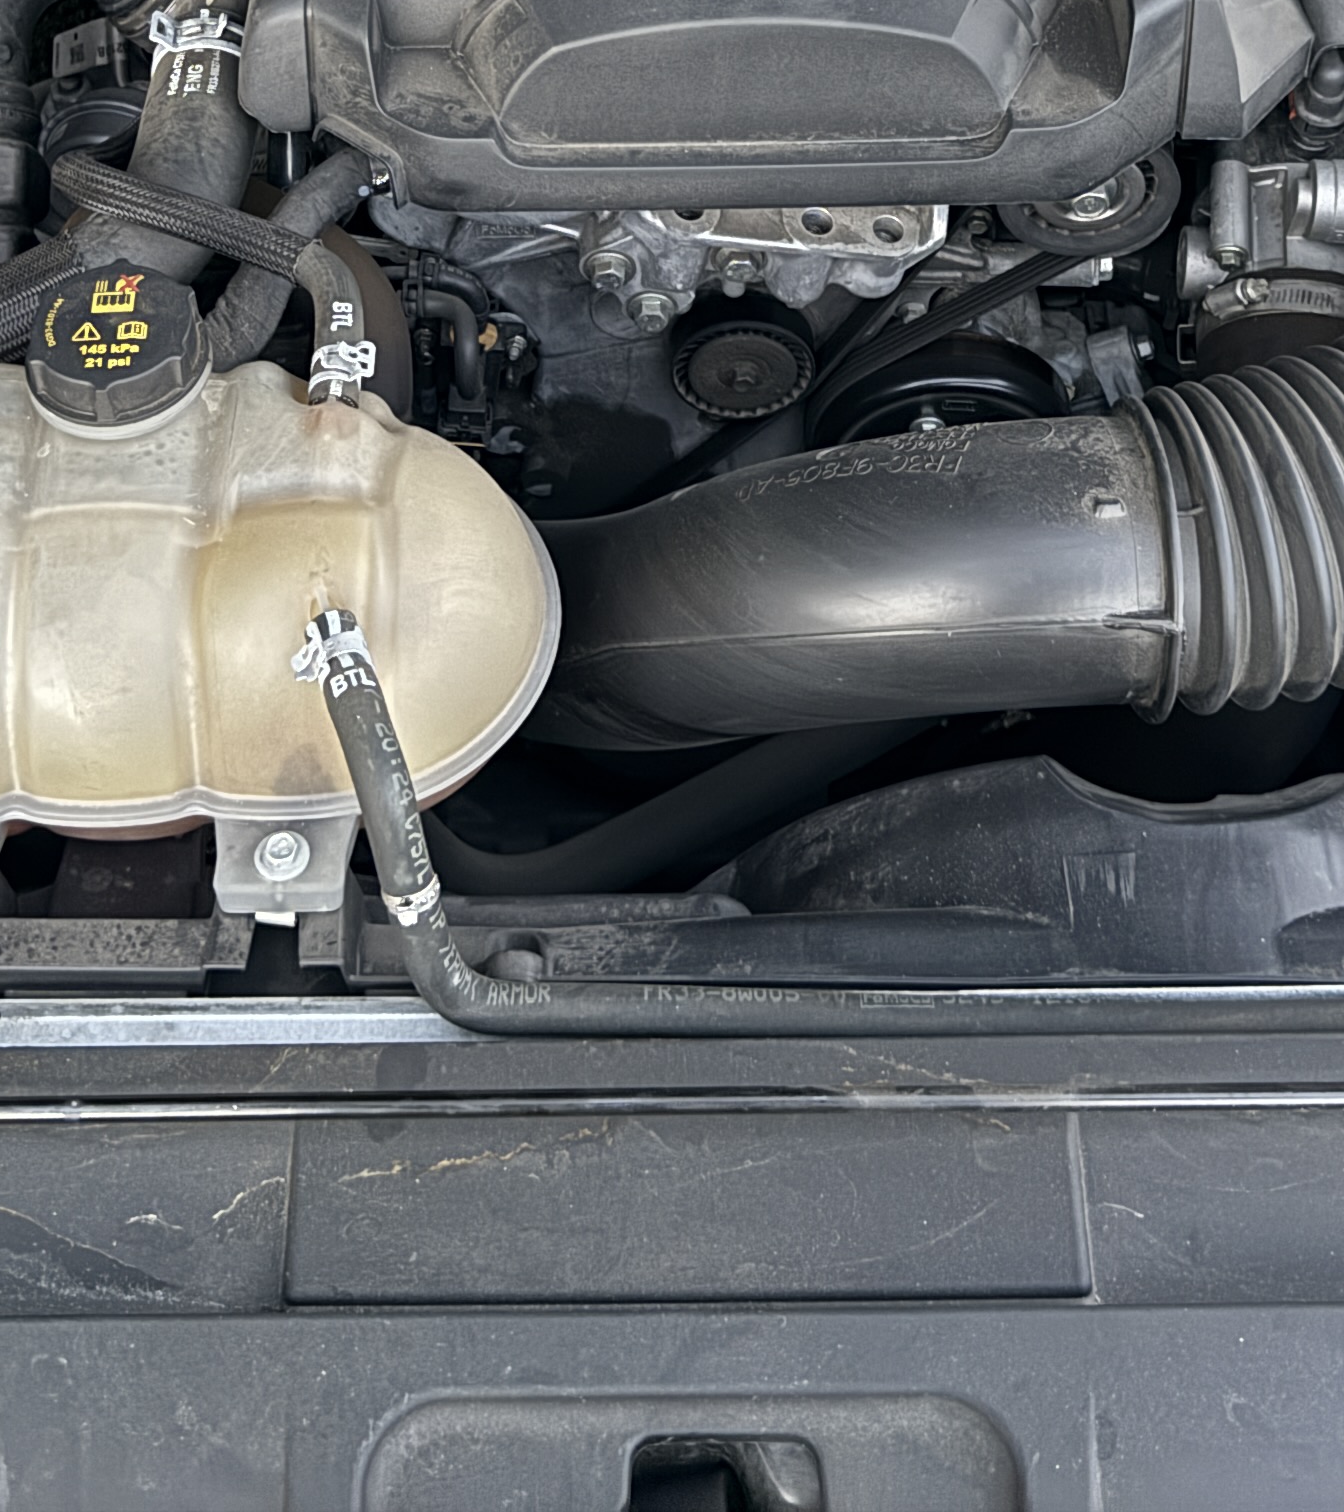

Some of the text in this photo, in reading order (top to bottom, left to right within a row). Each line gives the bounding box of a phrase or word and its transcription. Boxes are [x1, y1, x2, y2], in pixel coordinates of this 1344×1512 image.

[78, 343, 140, 355] 145 kPa
[84, 356, 132, 369] 21 psi
[329, 666, 377, 699] BTL
[486, 982, 552, 1006] ARMOR
